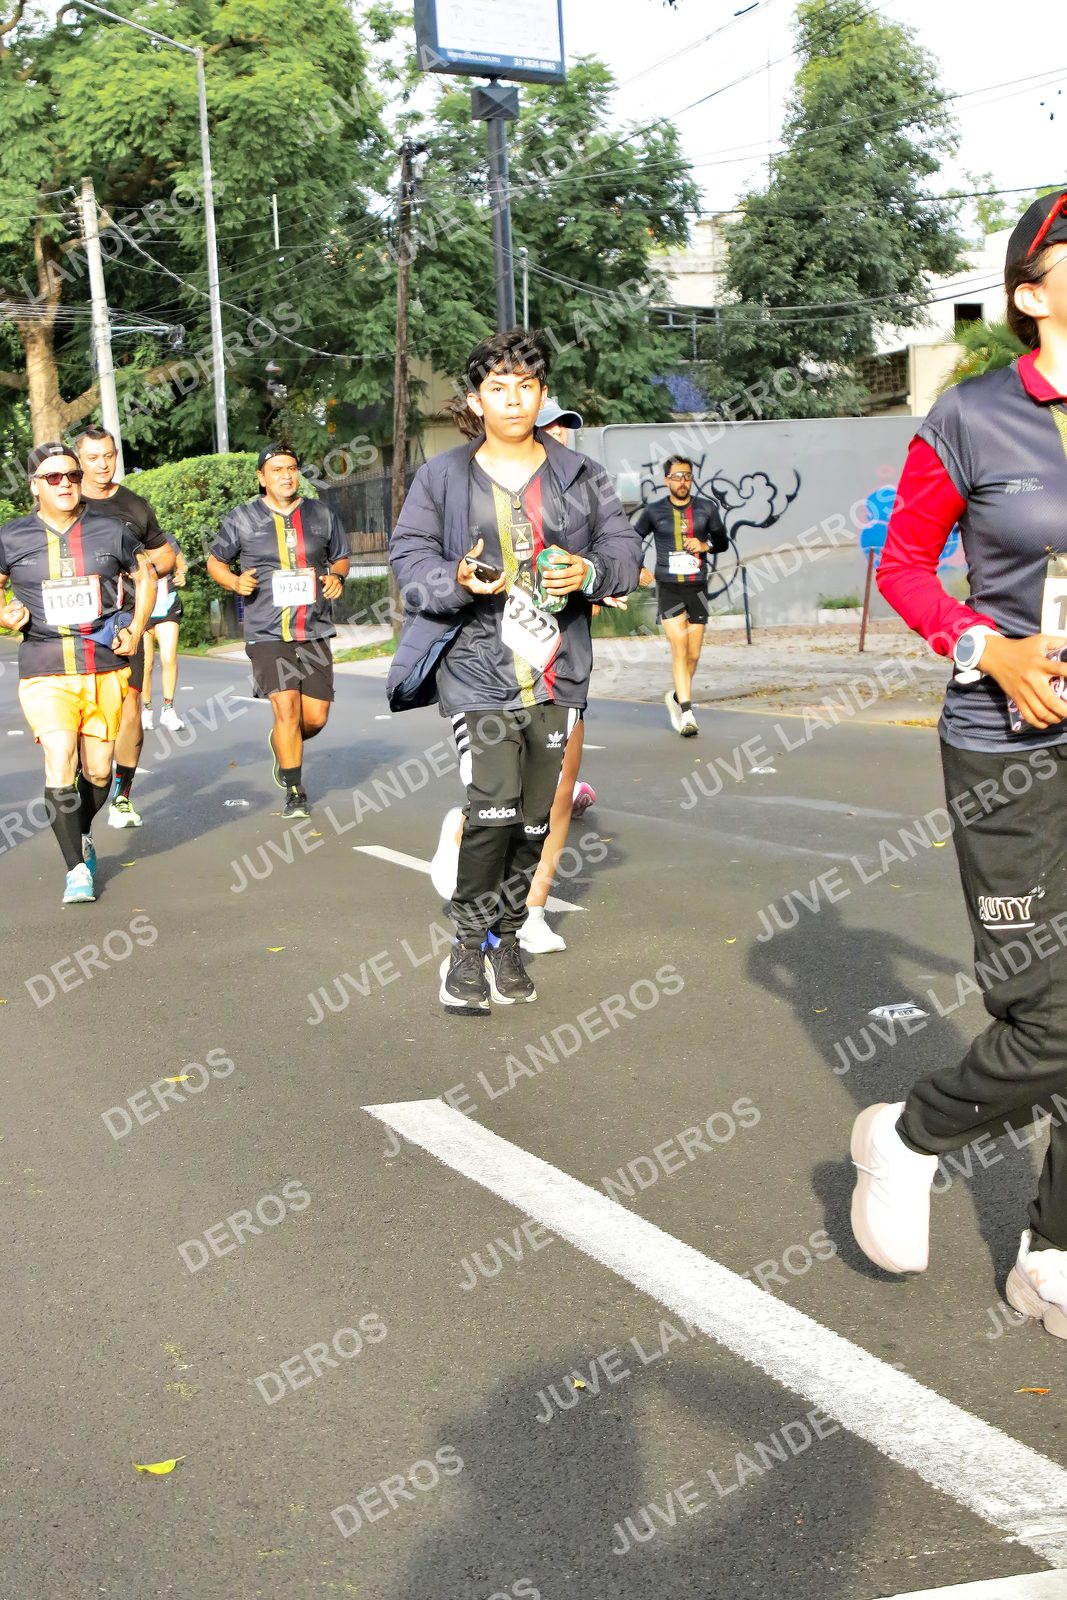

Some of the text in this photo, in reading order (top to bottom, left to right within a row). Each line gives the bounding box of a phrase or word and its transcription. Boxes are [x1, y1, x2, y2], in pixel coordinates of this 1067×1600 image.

[279, 581, 307, 594] 9342
[47, 591, 92, 610] 11601
[478, 806, 517, 819] adidas
